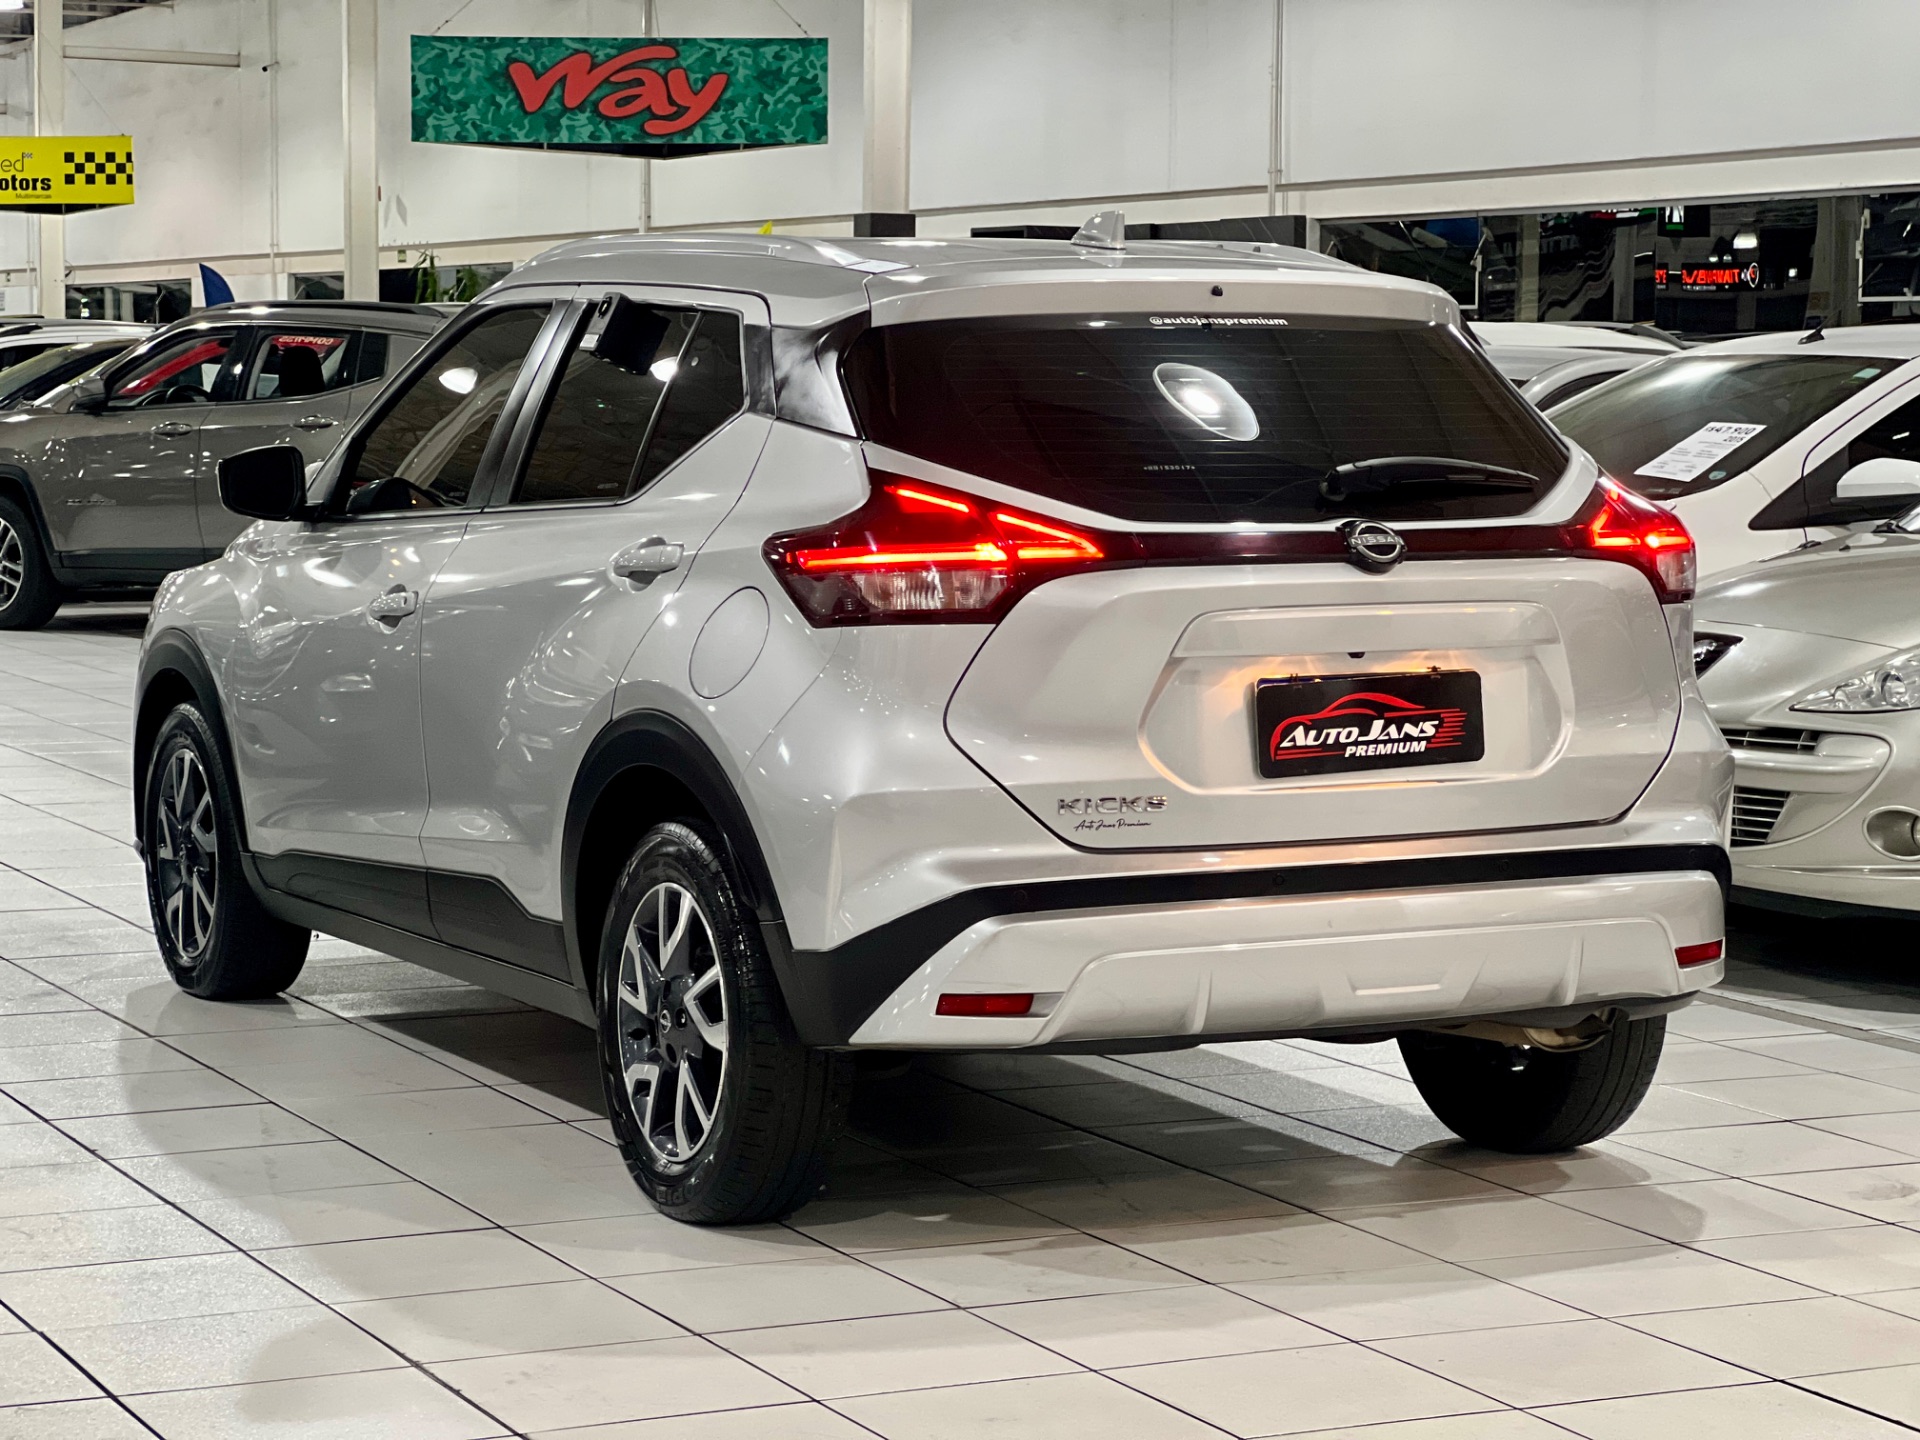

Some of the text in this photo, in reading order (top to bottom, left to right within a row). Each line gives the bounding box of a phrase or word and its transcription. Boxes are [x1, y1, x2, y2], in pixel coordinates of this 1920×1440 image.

[1149, 315, 1289, 327] @autojanspremium
[1351, 535, 1405, 546] NISSAN
[1344, 740, 1427, 758] PREMIUM
[1058, 796, 1168, 816] KICKS
